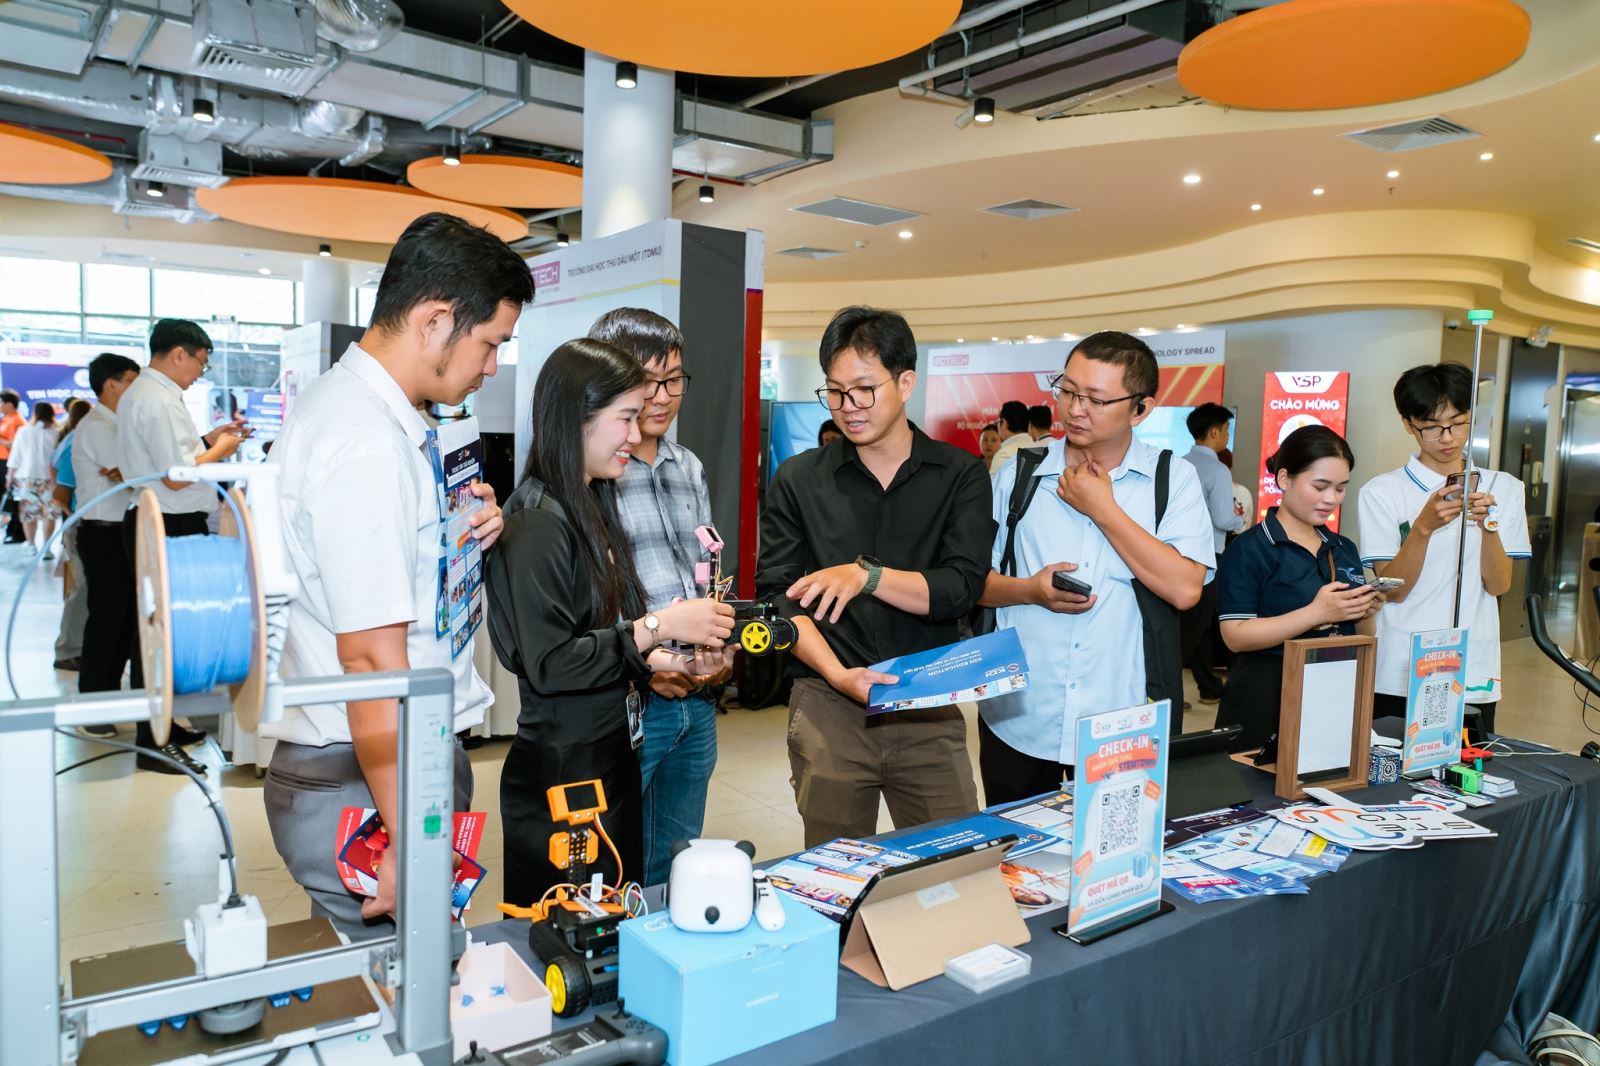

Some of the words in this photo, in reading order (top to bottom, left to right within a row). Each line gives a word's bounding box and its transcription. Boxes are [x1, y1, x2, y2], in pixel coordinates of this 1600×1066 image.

[1184, 346, 1215, 356] SPREAD
[1291, 375, 1322, 387] VSP
[1269, 398, 1303, 411] CHÀO
[1304, 396, 1340, 411] MỪNG
[1424, 649, 1457, 662] CHECK-IN
[928, 661, 969, 678] EDUCATION
[985, 666, 1006, 678] KDI
[1099, 734, 1150, 759] CHECK-IN
[1087, 882, 1106, 897] QUÉT
[1107, 877, 1118, 890] MÃ
[1119, 875, 1129, 886] QR
